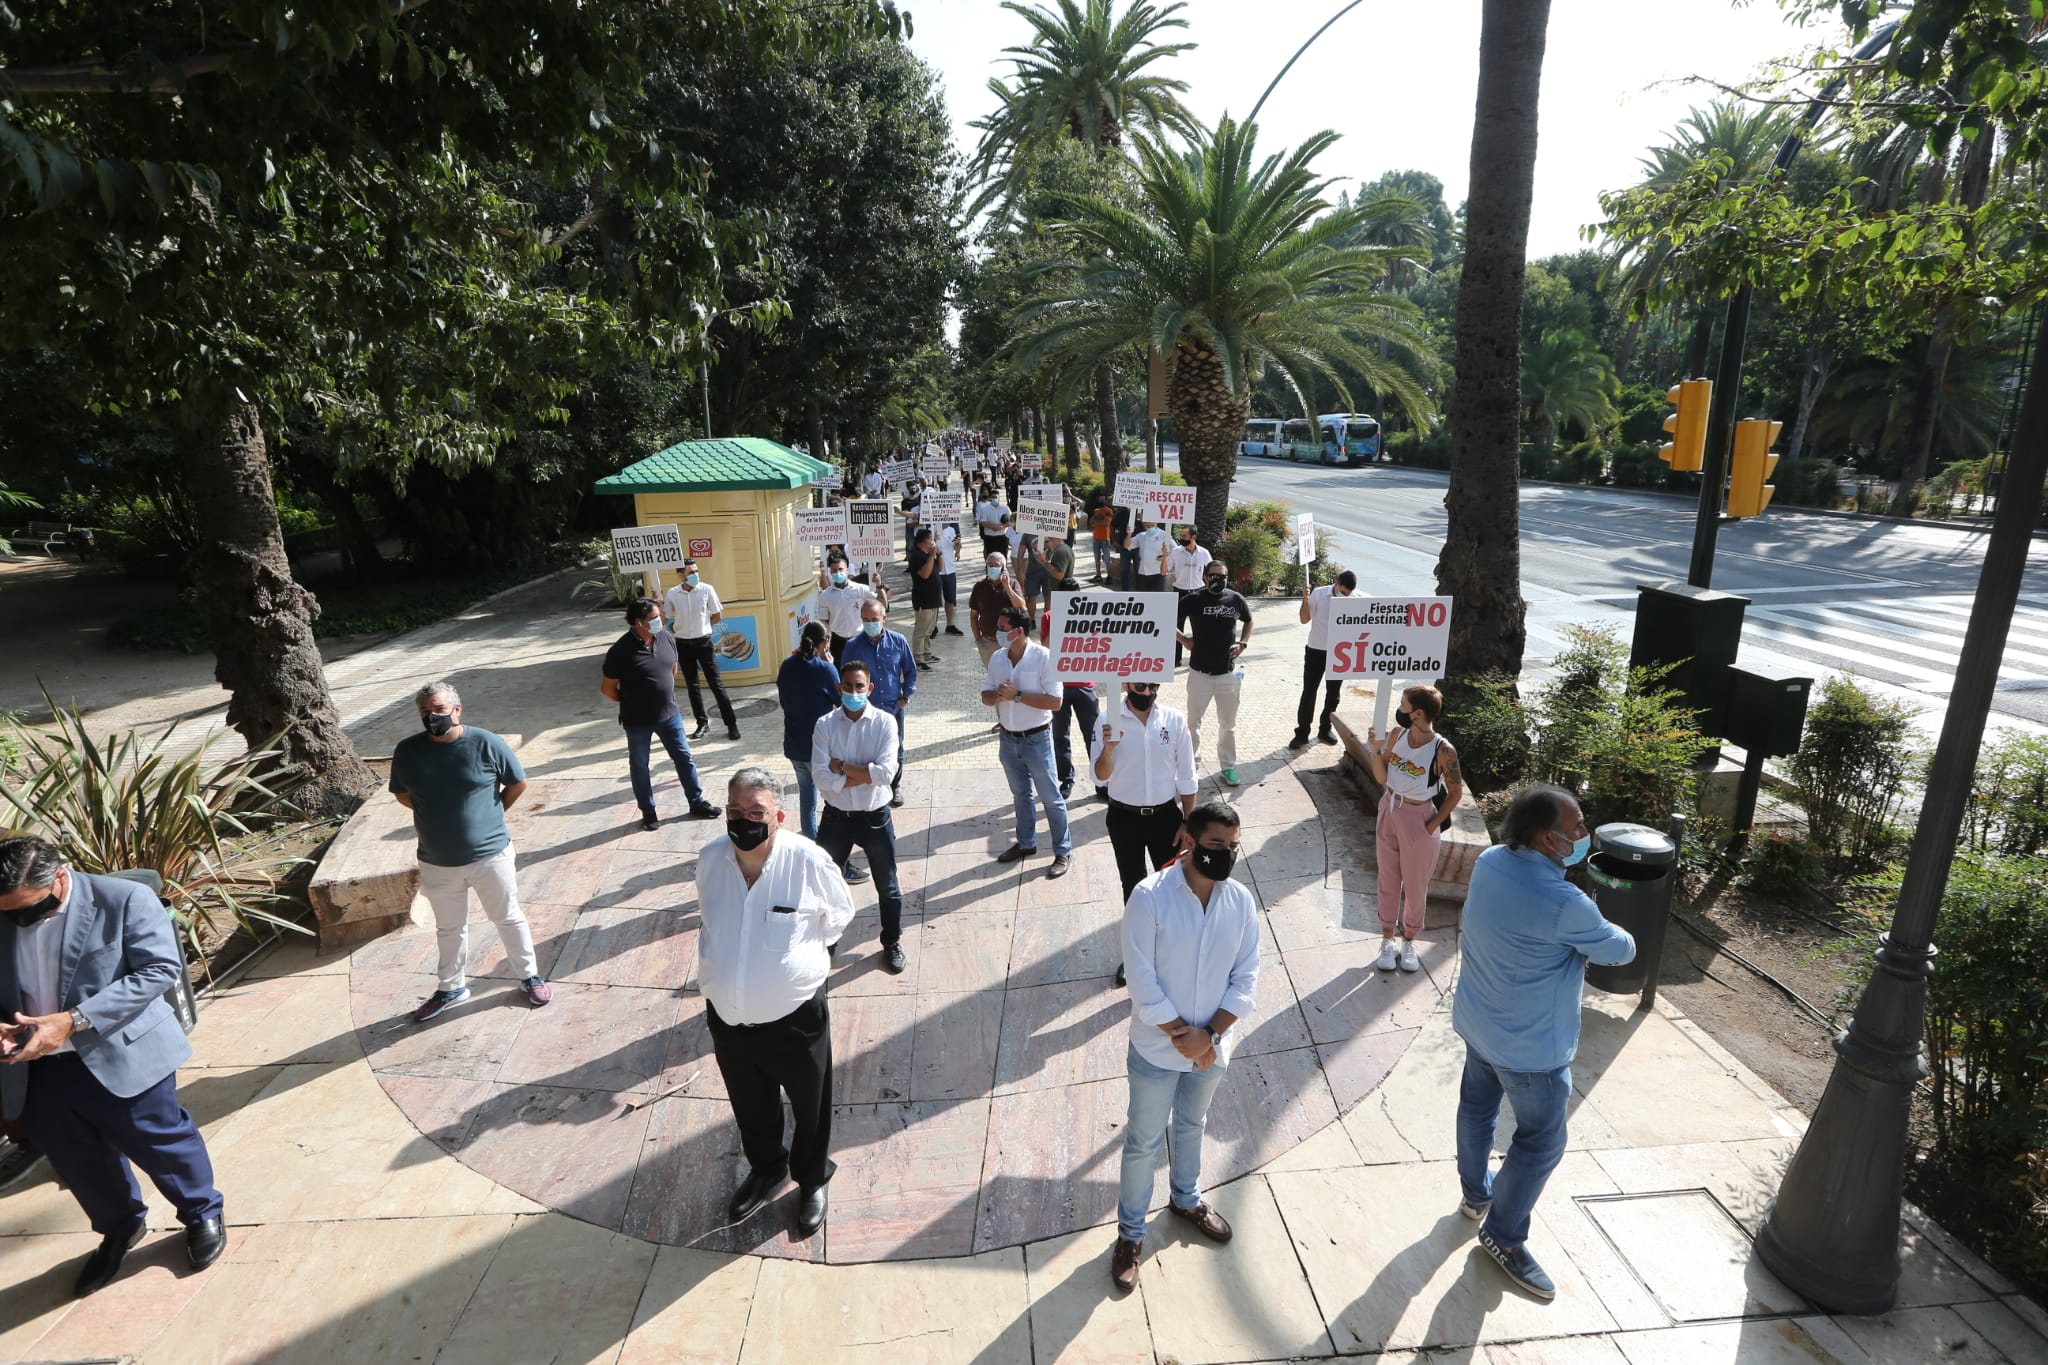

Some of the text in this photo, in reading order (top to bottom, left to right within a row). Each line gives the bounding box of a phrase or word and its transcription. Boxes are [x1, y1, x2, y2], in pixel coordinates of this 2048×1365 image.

[1146, 492, 1194, 504] ¡RESCATE
[1020, 504, 1035, 514] Nos
[1159, 504, 1184, 520] YA!
[825, 525, 844, 533] paga
[1034, 516, 1066, 526] seguimos
[1036, 524, 1065, 532] pagando
[614, 532, 678, 550] ERTES TOTALES
[810, 532, 842, 541] nuestro?
[874, 528, 886, 537] sin
[618, 546, 682, 566] HASTA 2021
[1068, 596, 1144, 616] Sin ocio
[1370, 602, 1446, 627] Fiestas NO
[1064, 618, 1160, 637] nocturno,
[1336, 614, 1409, 625] clandestinas
[1060, 630, 1112, 653] más
[1332, 632, 1407, 674] SÍ Ocio
[1056, 652, 1165, 677] contagios
[1371, 656, 1440, 676] regulado
